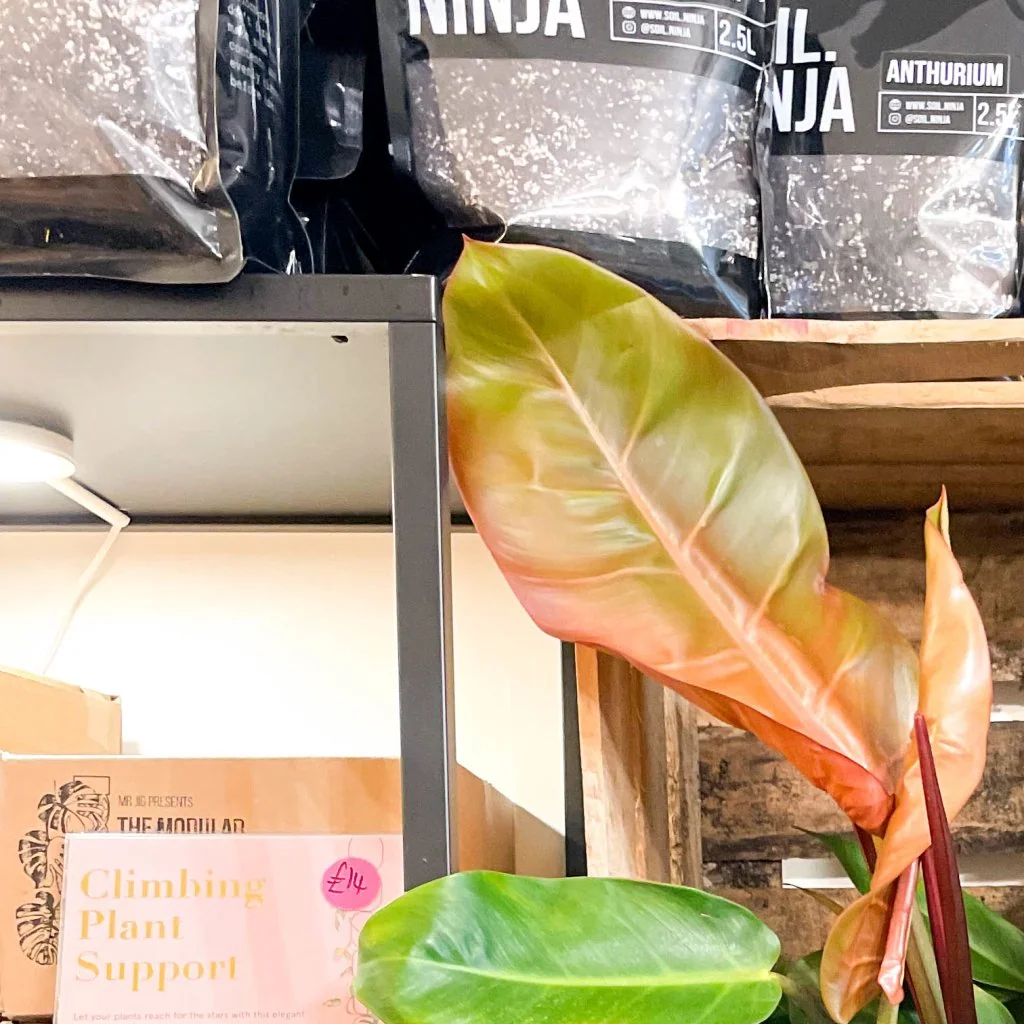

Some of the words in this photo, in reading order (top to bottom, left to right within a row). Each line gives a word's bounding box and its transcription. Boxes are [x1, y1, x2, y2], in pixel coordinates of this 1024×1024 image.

[408, 0, 586, 39] NINJA
[719, 19, 757, 57] 2.5L
[885, 58, 1004, 87] ANTHURIUM
[118, 795, 133, 807] MR
[148, 796, 194, 808] PRESENTS
[117, 816, 152, 834] THE
[79, 867, 267, 909] Climbing
[326, 861, 368, 894] £14
[78, 908, 185, 941] Plant
[74, 951, 239, 993] Support
[91, 1014, 111, 1022] your
[114, 1012, 141, 1022] plants
[144, 1012, 171, 1021] reach
[174, 1011, 188, 1020] for
[272, 1010, 305, 1021] elegant
